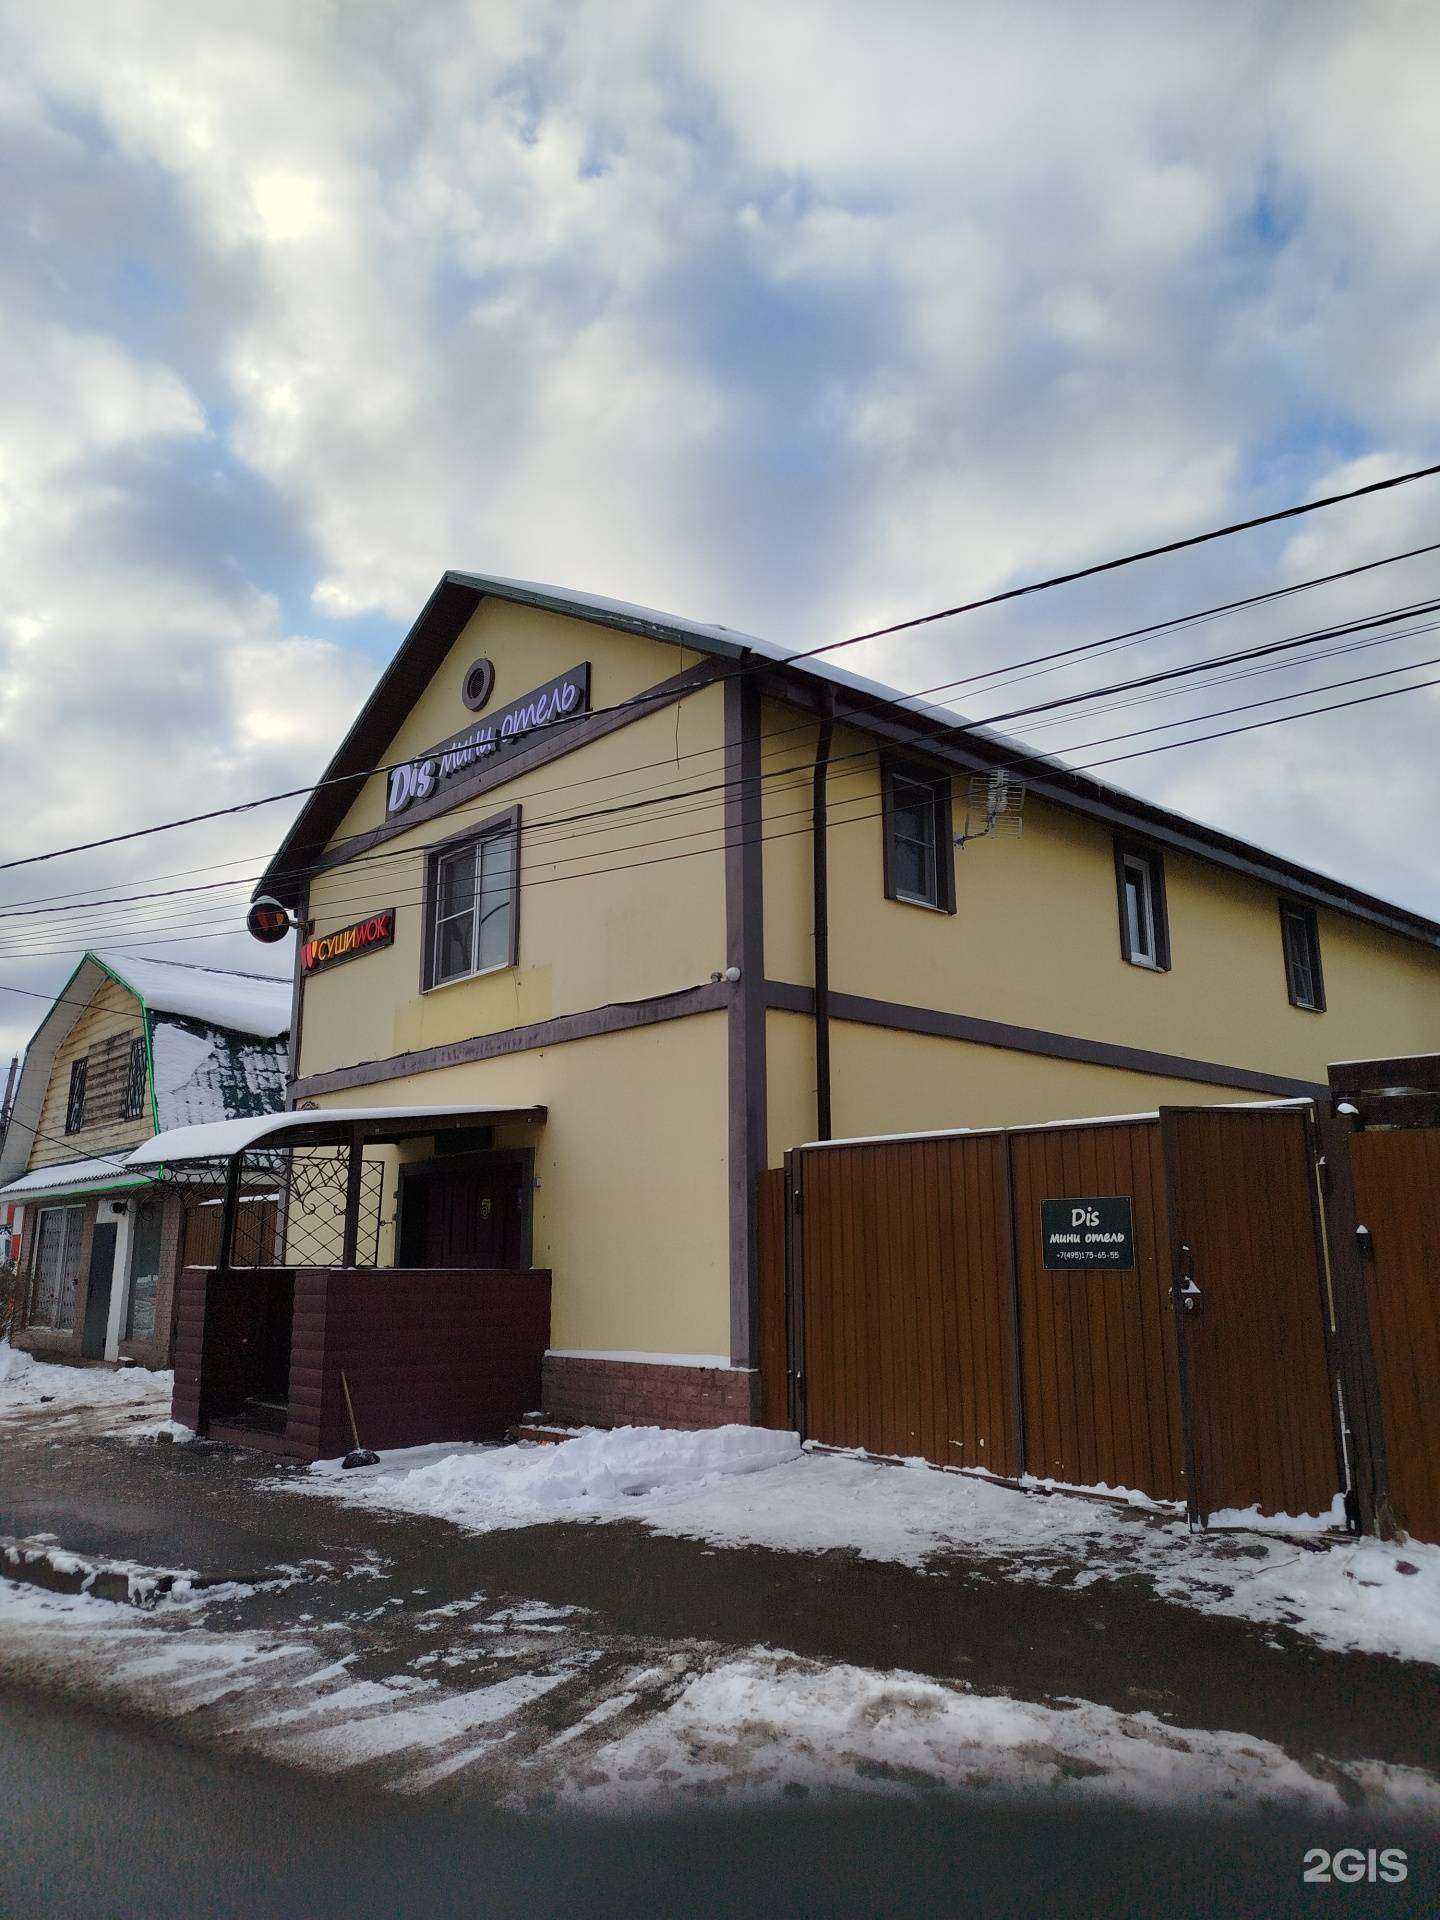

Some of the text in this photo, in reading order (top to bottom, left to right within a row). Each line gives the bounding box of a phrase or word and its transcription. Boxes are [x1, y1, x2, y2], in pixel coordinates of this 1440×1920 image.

[388, 762, 435, 812] Dis
[501, 682, 577, 743] отель
[1071, 1206, 1100, 1227] Dis
[1049, 1232, 1125, 1244] мини отель
[1056, 1251, 1120, 1260] +7(495)175-65-55
